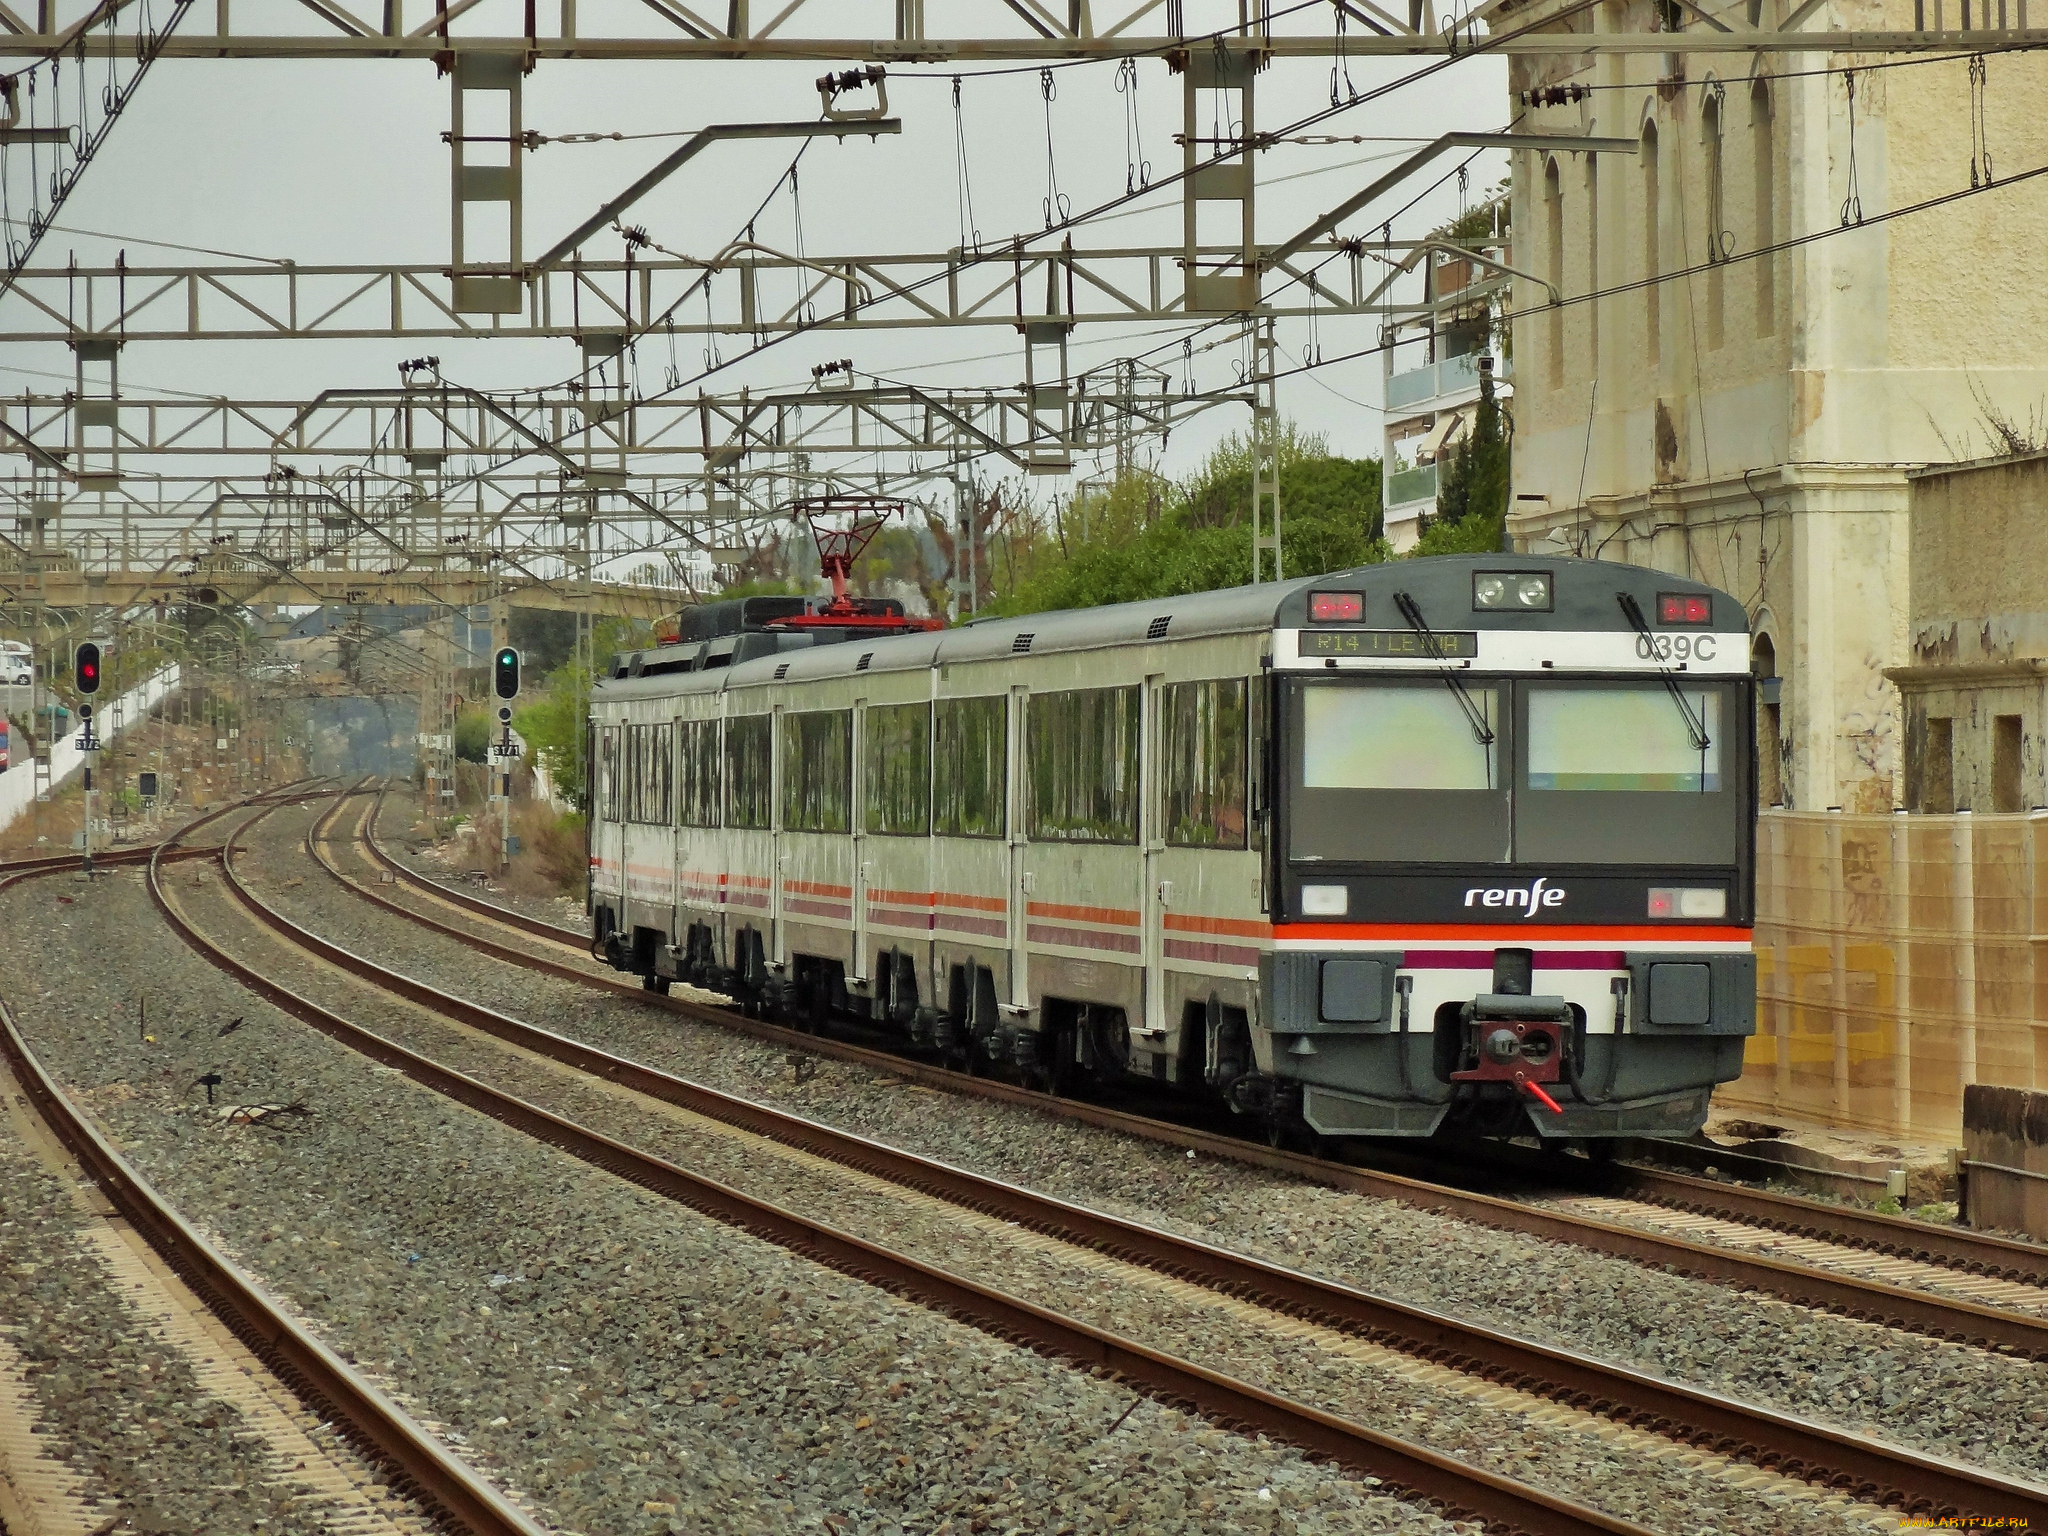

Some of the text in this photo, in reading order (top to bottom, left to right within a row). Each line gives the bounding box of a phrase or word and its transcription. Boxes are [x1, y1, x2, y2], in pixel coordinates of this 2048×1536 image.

[1317, 634, 1359, 651] R14
[1635, 634, 1717, 661] 039C
[1464, 877, 1566, 918] renfe
